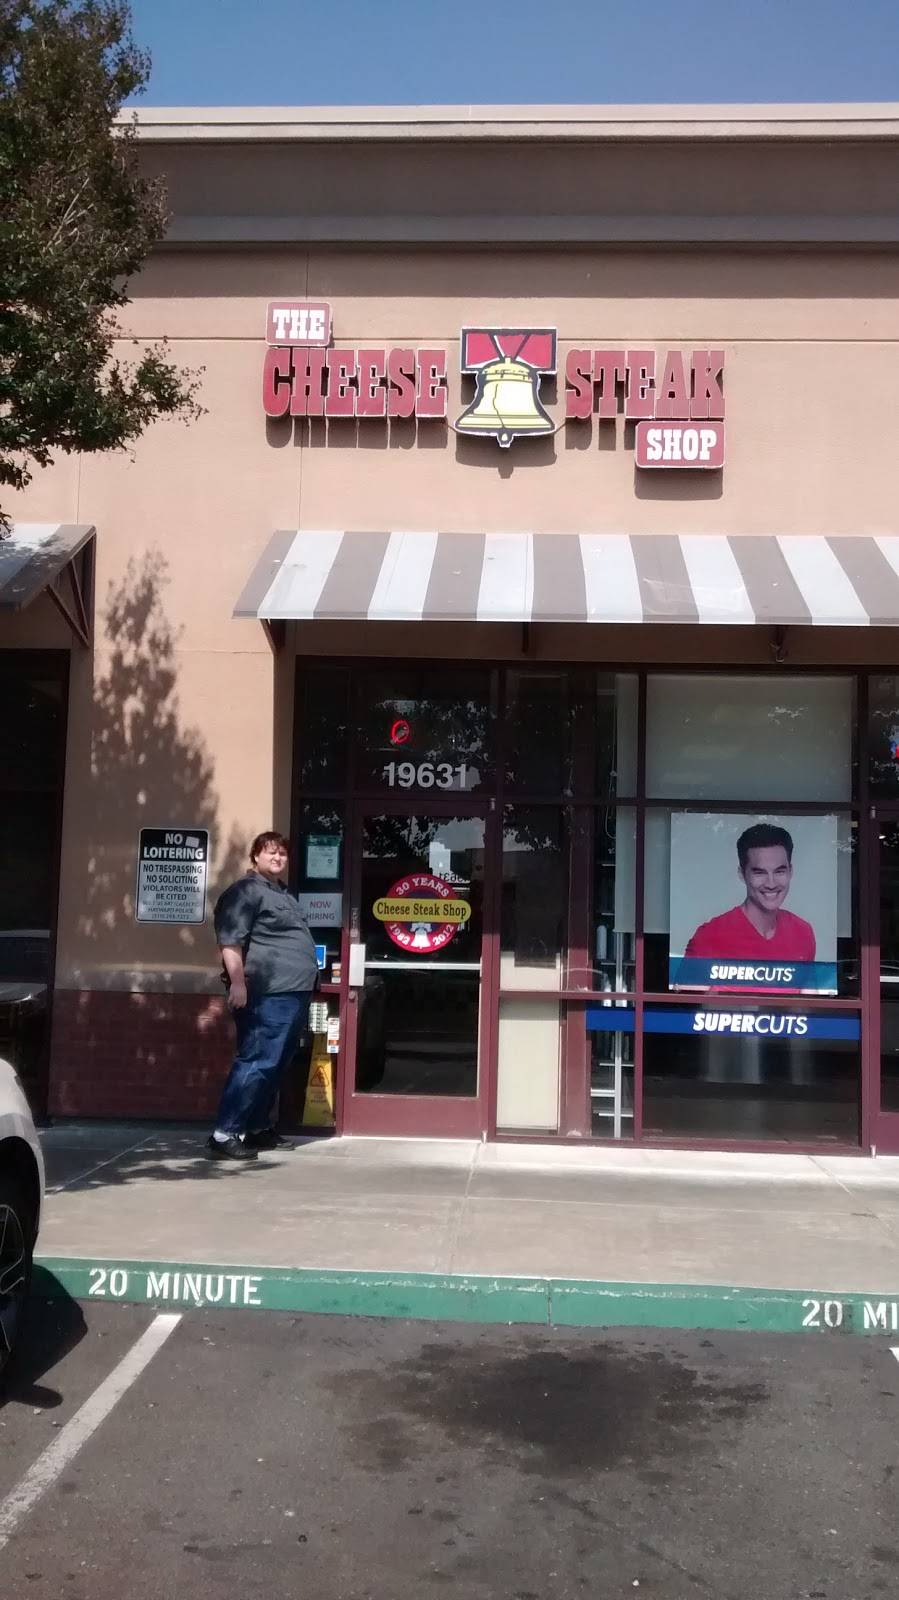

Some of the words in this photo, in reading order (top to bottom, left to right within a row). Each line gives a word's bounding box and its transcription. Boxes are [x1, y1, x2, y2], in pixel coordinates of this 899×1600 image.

[272, 309, 326, 340] THE
[262, 348, 448, 418] CHEESE
[565, 349, 726, 420] STEAK
[646, 429, 718, 461] SHOP
[383, 762, 468, 788] 19631
[165, 833, 182, 844] NO
[143, 846, 203, 859] LOITERING
[143, 864, 153, 872] NO
[155, 864, 202, 873] TRESPASSING
[147, 875, 157, 883] NO
[158, 875, 198, 884] SOLICITING
[395, 882, 410, 896] 30
[412, 877, 450, 897] YEARS
[310, 901, 331, 909] NOW
[377, 902, 410, 915] Cheese
[413, 903, 440, 916] Steak
[443, 904, 467, 919] Shop
[306, 912, 335, 920] HIRING
[389, 924, 411, 946] 1982
[432, 924, 454, 946] 2012
[693, 1012, 809, 1035] SUPERCUTS
[88, 1268, 128, 1296] 20
[146, 1271, 263, 1305] MINUTE
[801, 1299, 843, 1327] 20
[863, 1301, 898, 1330] MI
